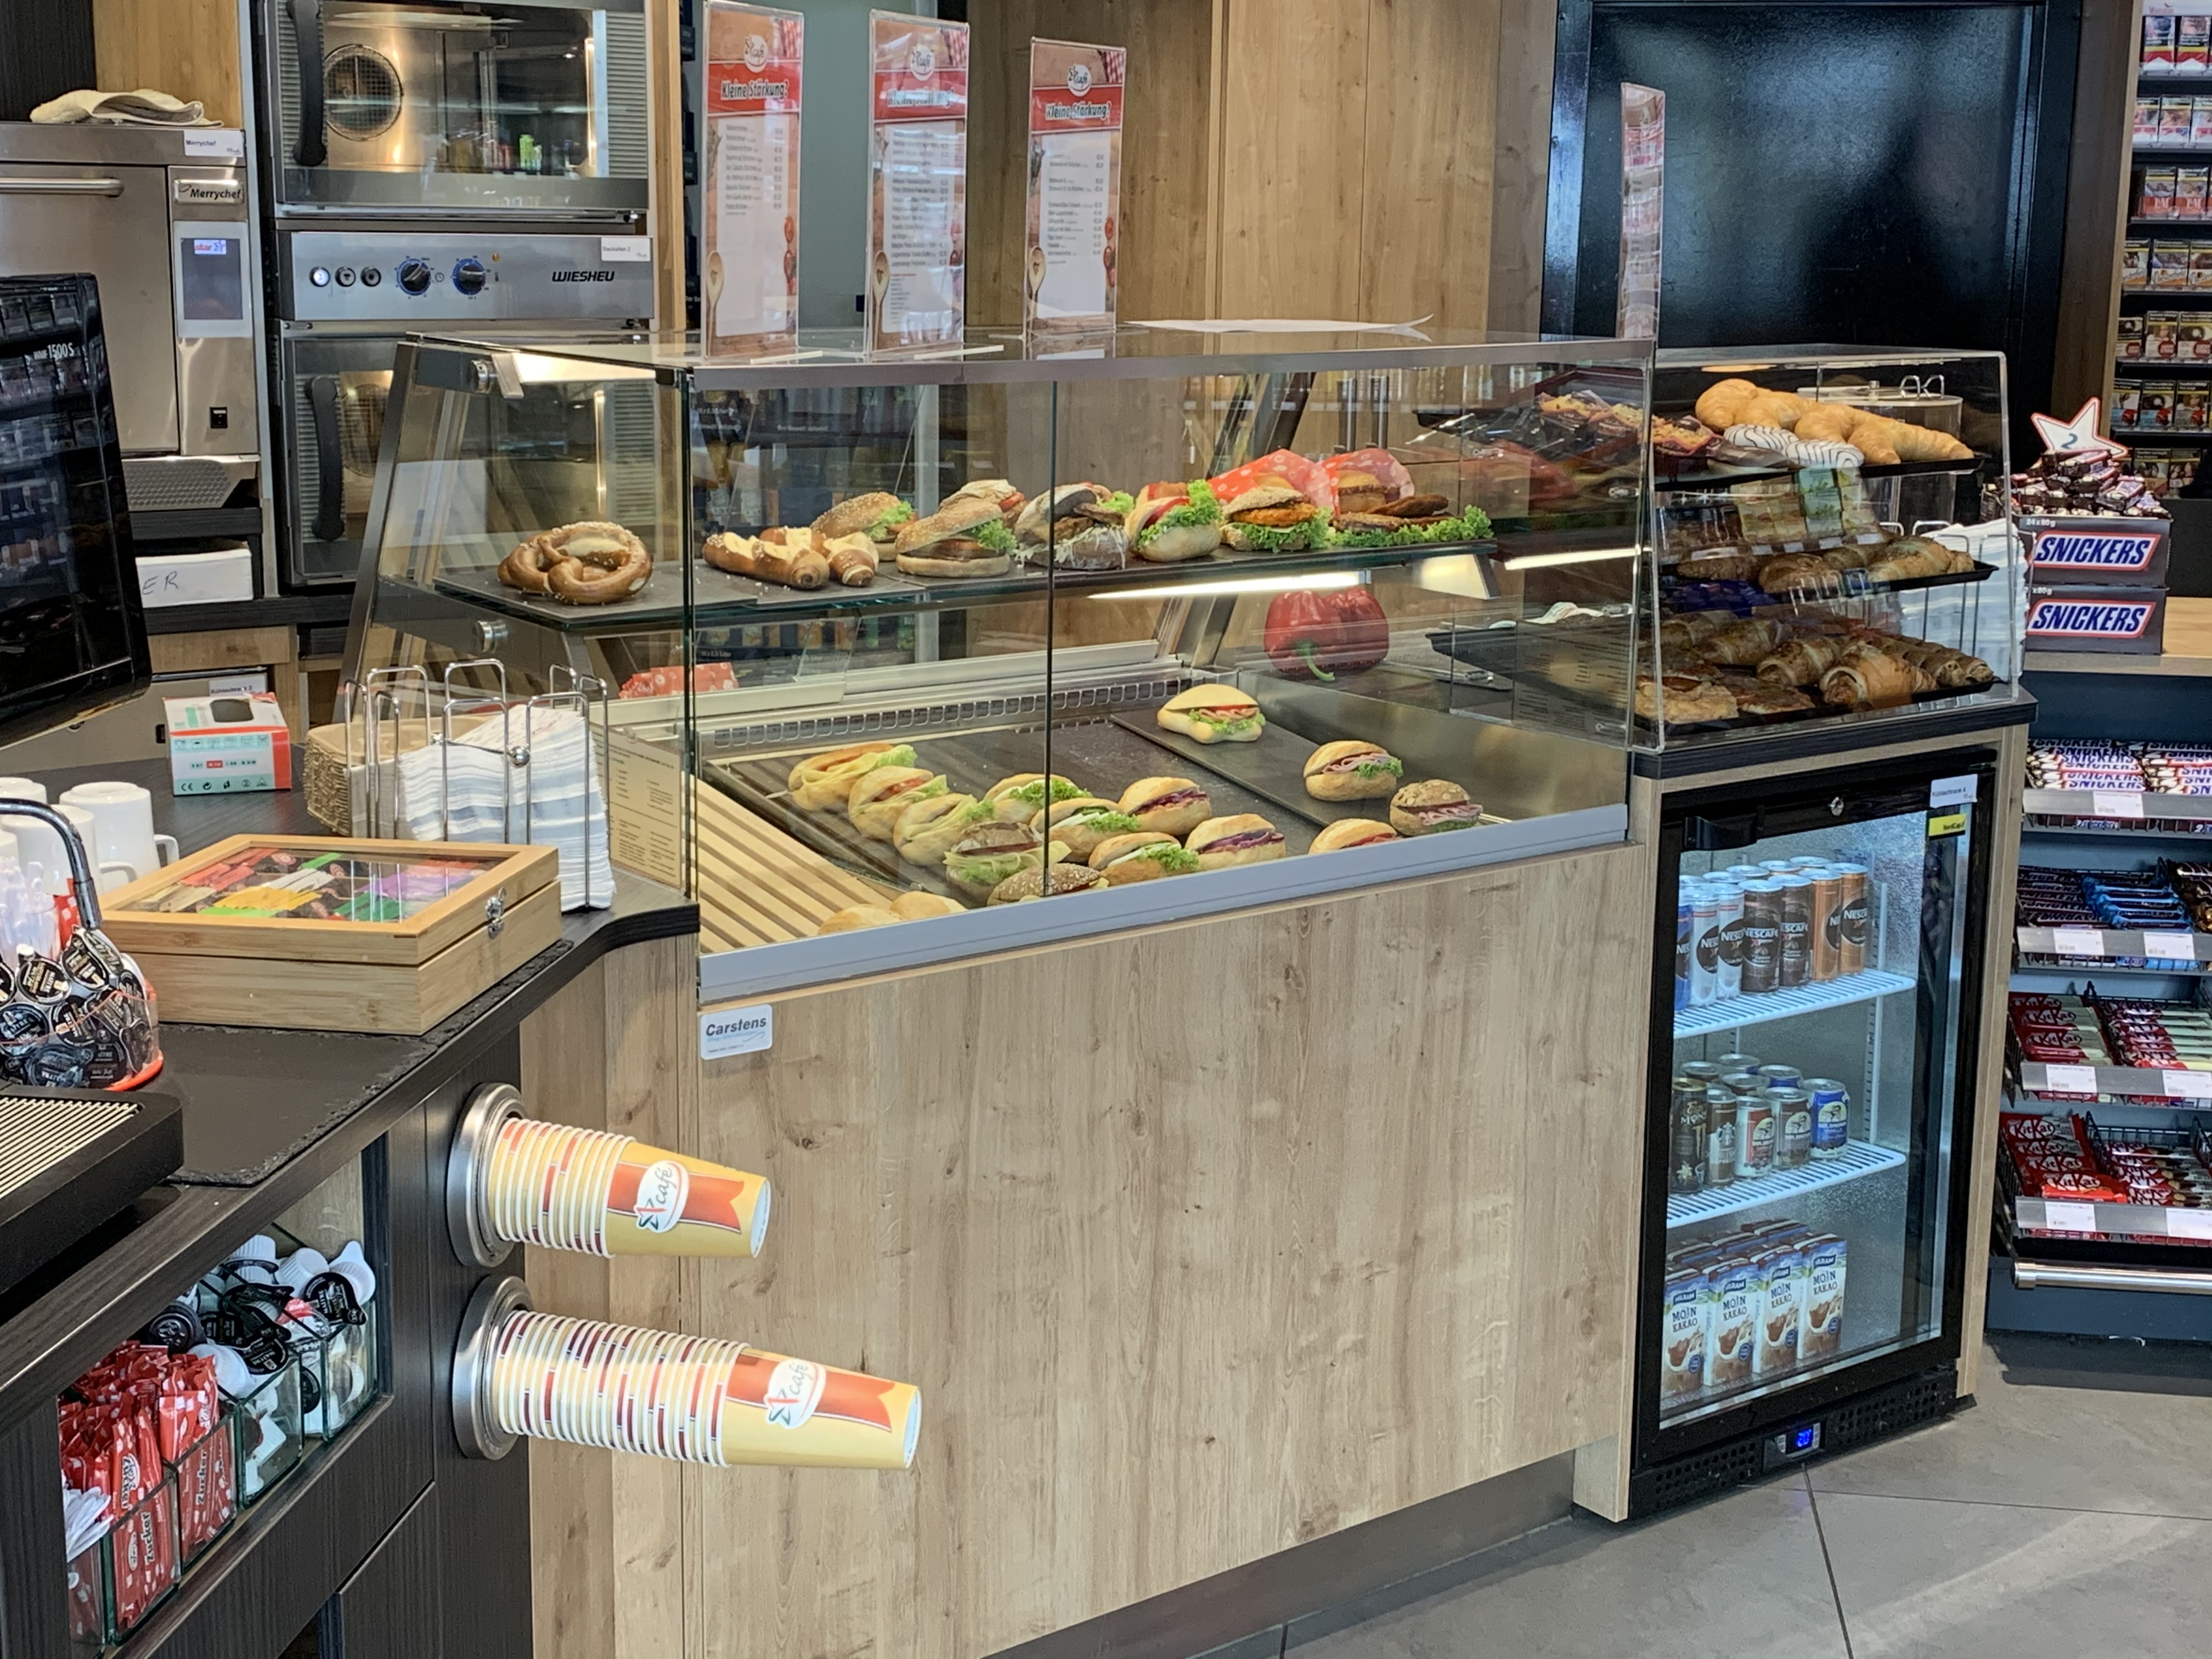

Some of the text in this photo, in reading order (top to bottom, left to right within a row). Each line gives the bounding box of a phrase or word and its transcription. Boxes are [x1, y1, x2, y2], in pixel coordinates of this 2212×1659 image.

[721, 80, 788, 99] Kleine Stärkung?
[190, 189, 241, 200] Merrychef
[552, 271, 615, 282] WIESHEU
[2034, 537, 2151, 565] SNICKERS
[2032, 605, 2146, 632] SNICKERS
[2061, 755, 2134, 763] SNICKERS
[706, 1018, 766, 1036] Carstens
[2033, 1032, 2083, 1046] KitKat
[2009, 1119, 2056, 1139] KitKat
[2018, 1141, 2064, 1154] KitKat
[2030, 1155, 2083, 1172] KitKat
[654, 1166, 677, 1204] café
[2046, 1173, 2101, 1191] KitKat
[1813, 1270, 1836, 1285] MOIN
[1770, 1282, 1791, 1299] MOIN
[1813, 1282, 1838, 1295] KAKAO
[1723, 1295, 1746, 1311] MOIN
[1771, 1294, 1792, 1308] KAKAO
[1672, 1307, 1697, 1322] MOIN
[1723, 1306, 1747, 1321] KAKAO
[1672, 1318, 1698, 1333] KAKAO
[788, 1362, 814, 1395] café
[196, 1450, 207, 1505] Zucker
[141, 1511, 155, 1563] Zucker
